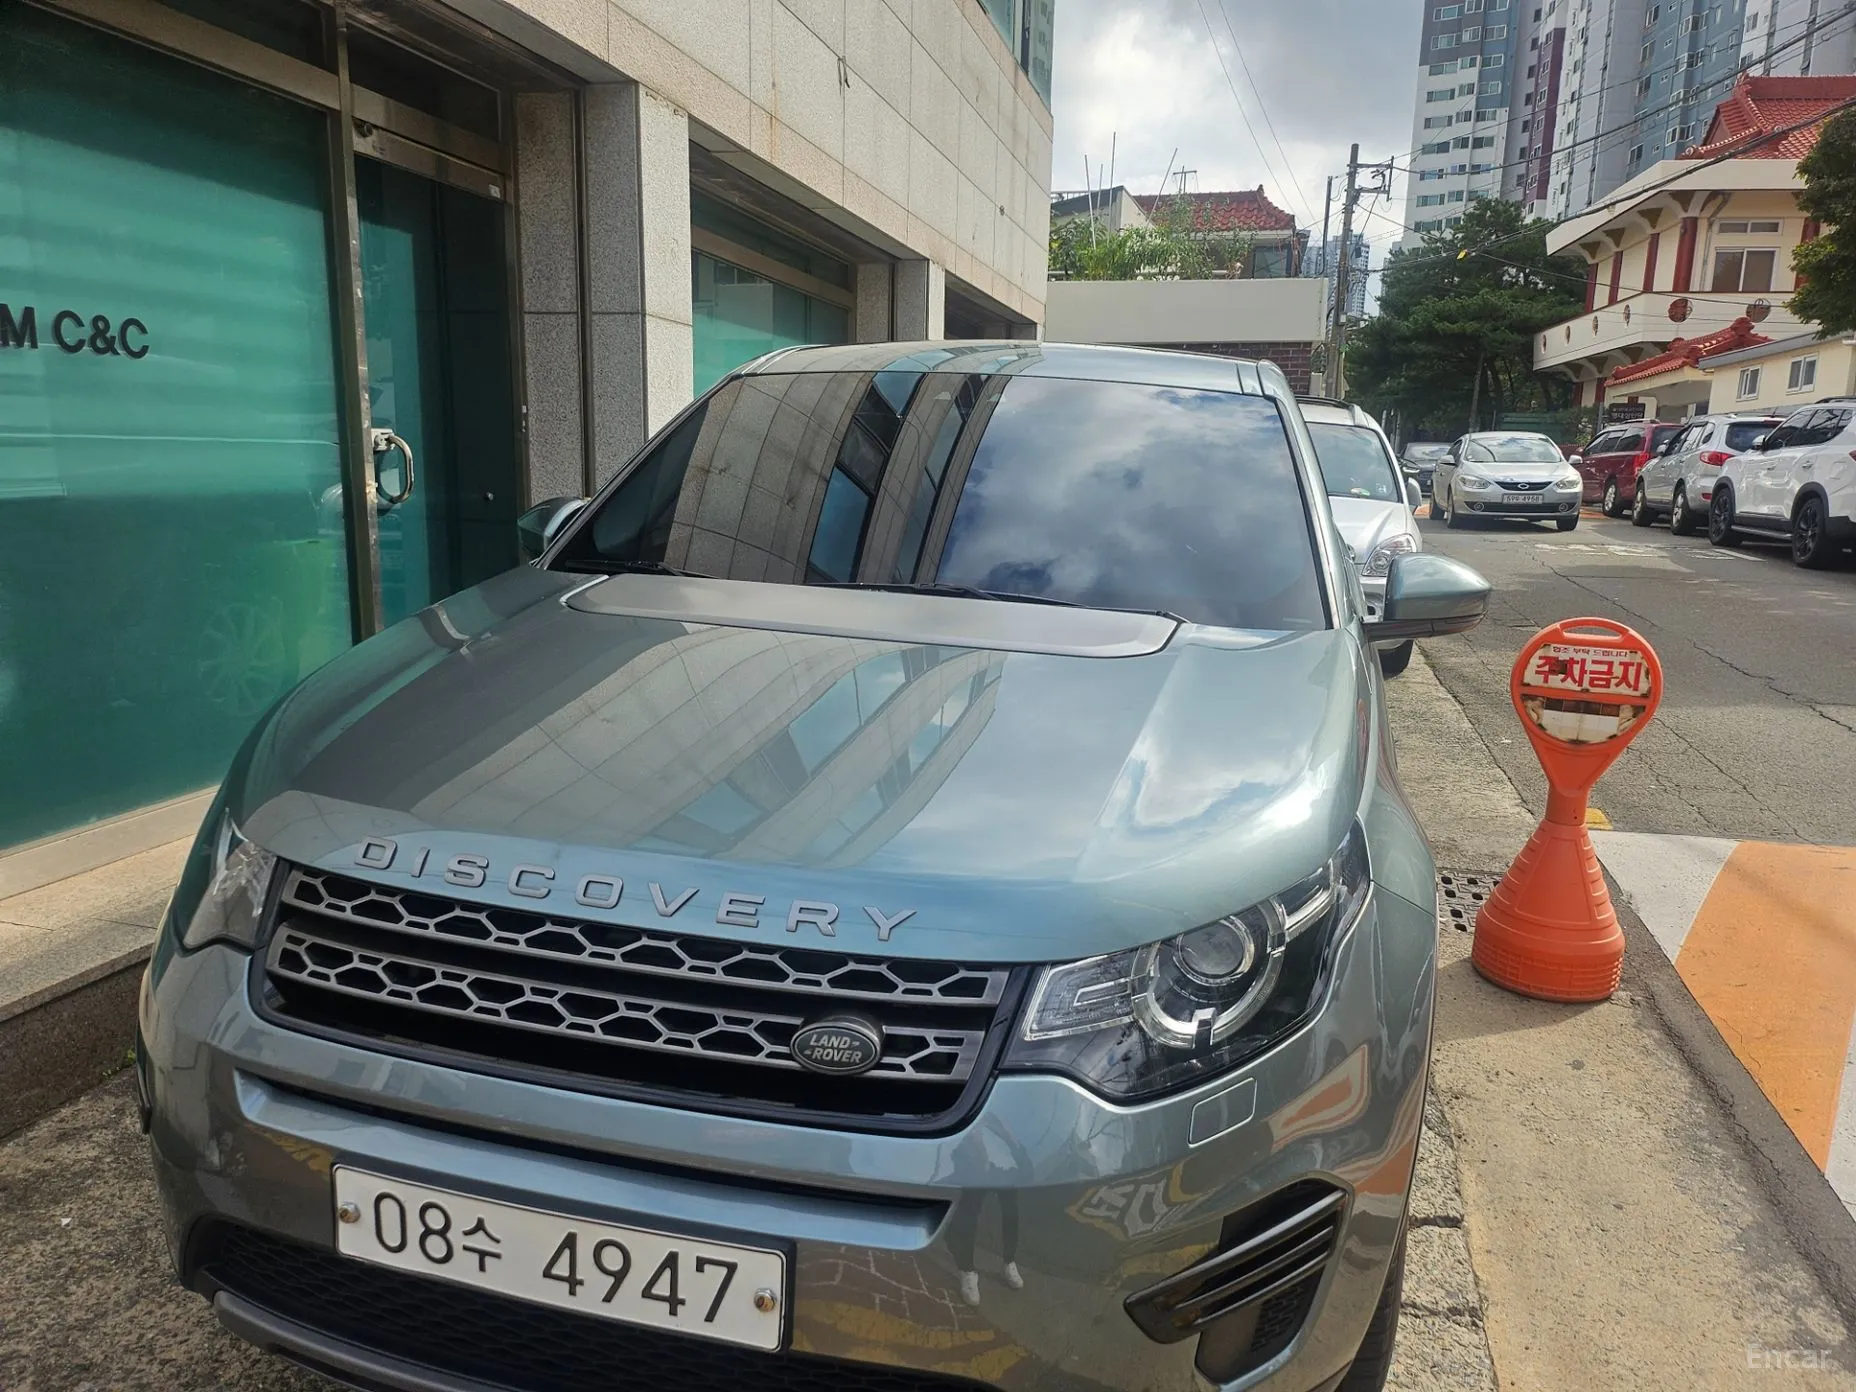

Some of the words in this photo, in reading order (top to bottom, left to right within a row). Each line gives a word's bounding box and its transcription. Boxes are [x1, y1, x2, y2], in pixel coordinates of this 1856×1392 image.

[54, 310, 149, 359] C&C
[1535, 656, 1642, 691] 주차금지
[354, 836, 918, 942] DISCOVERY
[809, 1034, 851, 1048] LAND
[812, 1048, 862, 1063] ROVER
[373, 1191, 502, 1273] 08수
[542, 1231, 739, 1323] 4947
